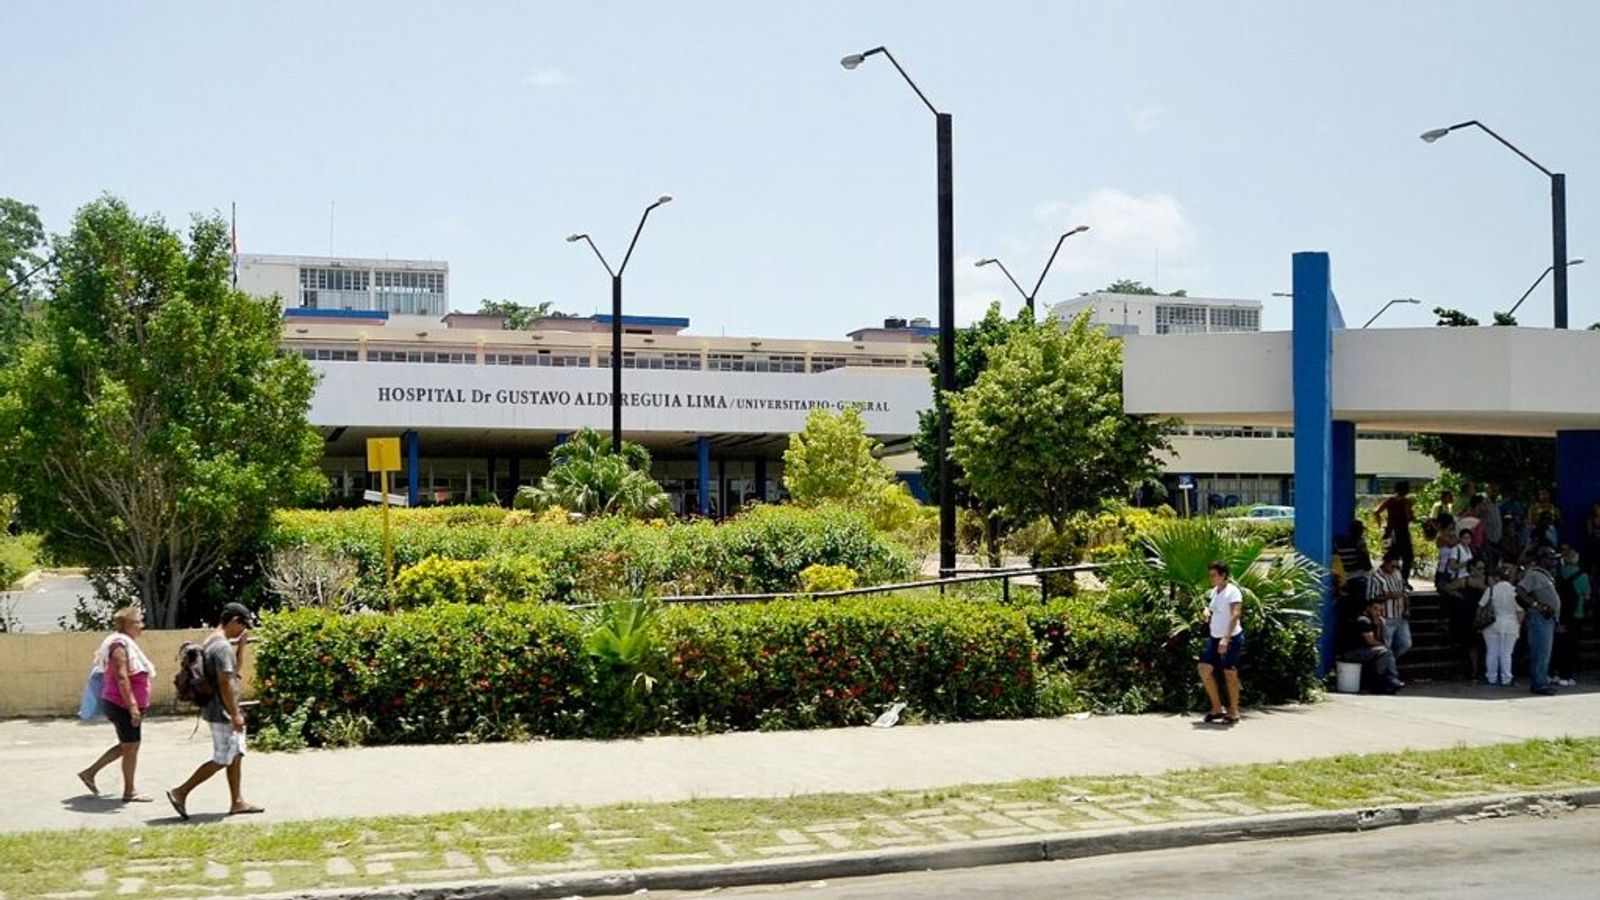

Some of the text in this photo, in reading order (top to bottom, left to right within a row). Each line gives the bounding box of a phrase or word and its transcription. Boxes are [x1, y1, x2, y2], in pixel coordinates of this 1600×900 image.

[378, 386, 466, 403] HOSPITAL
[471, 387, 492, 403] Dr
[496, 389, 571, 405] GUSTAVO
